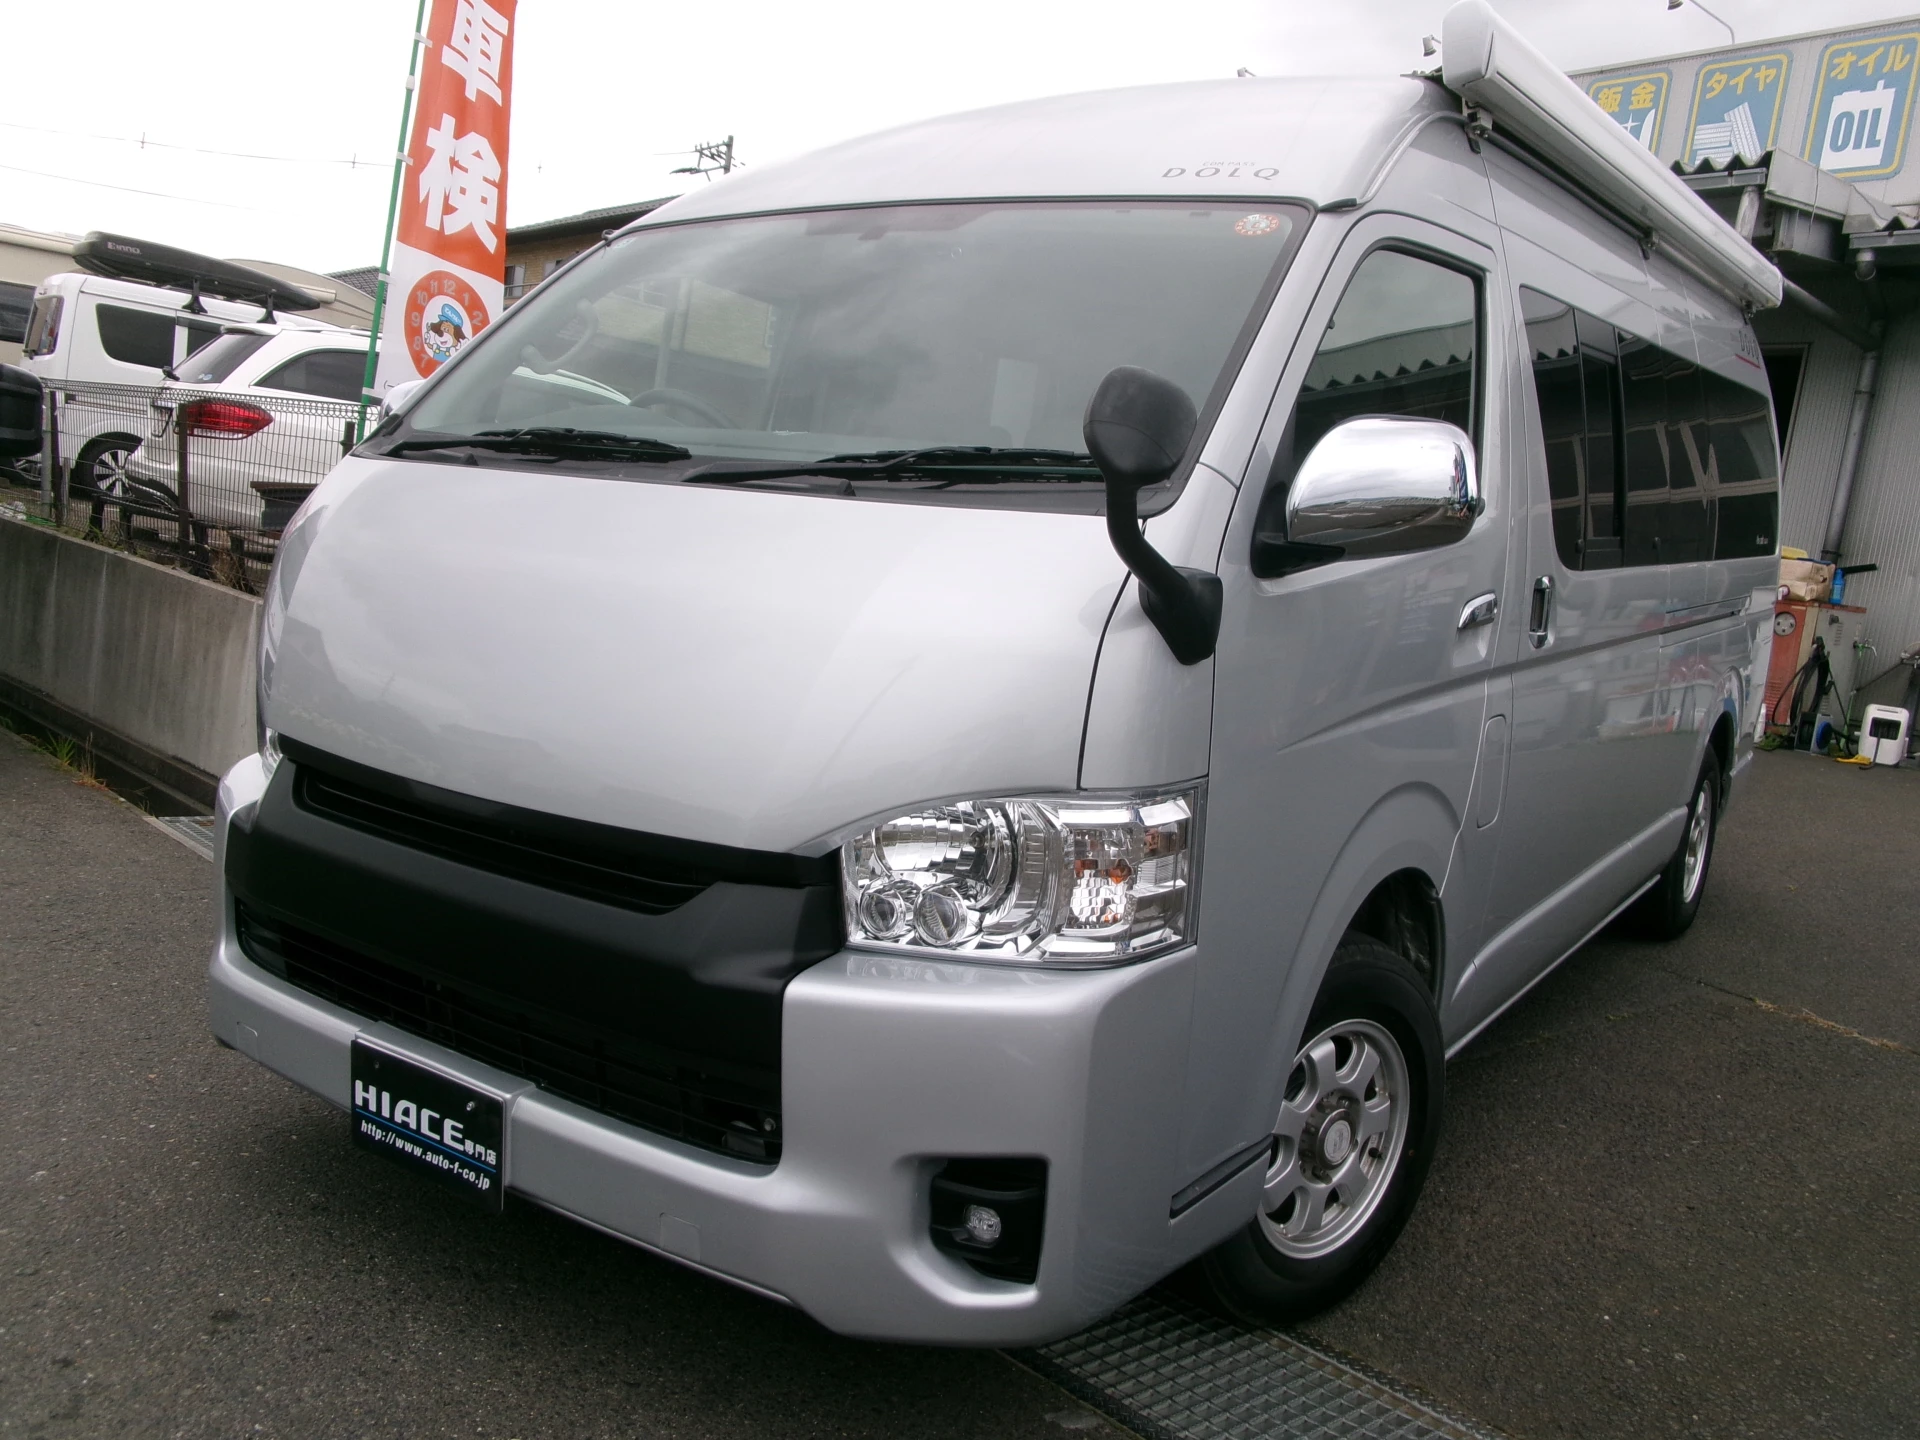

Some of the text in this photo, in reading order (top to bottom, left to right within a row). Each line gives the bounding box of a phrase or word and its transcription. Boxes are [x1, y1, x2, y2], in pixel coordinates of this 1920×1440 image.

[1830, 43, 1911, 80] オイル
[1705, 64, 1778, 99] タイヤ
[419, 0, 509, 253] 車検
[1828, 107, 1883, 154] OIL
[1161, 167, 1280, 180] DOLQ
[443, 278, 456, 295] 12
[472, 310, 483, 326] 2
